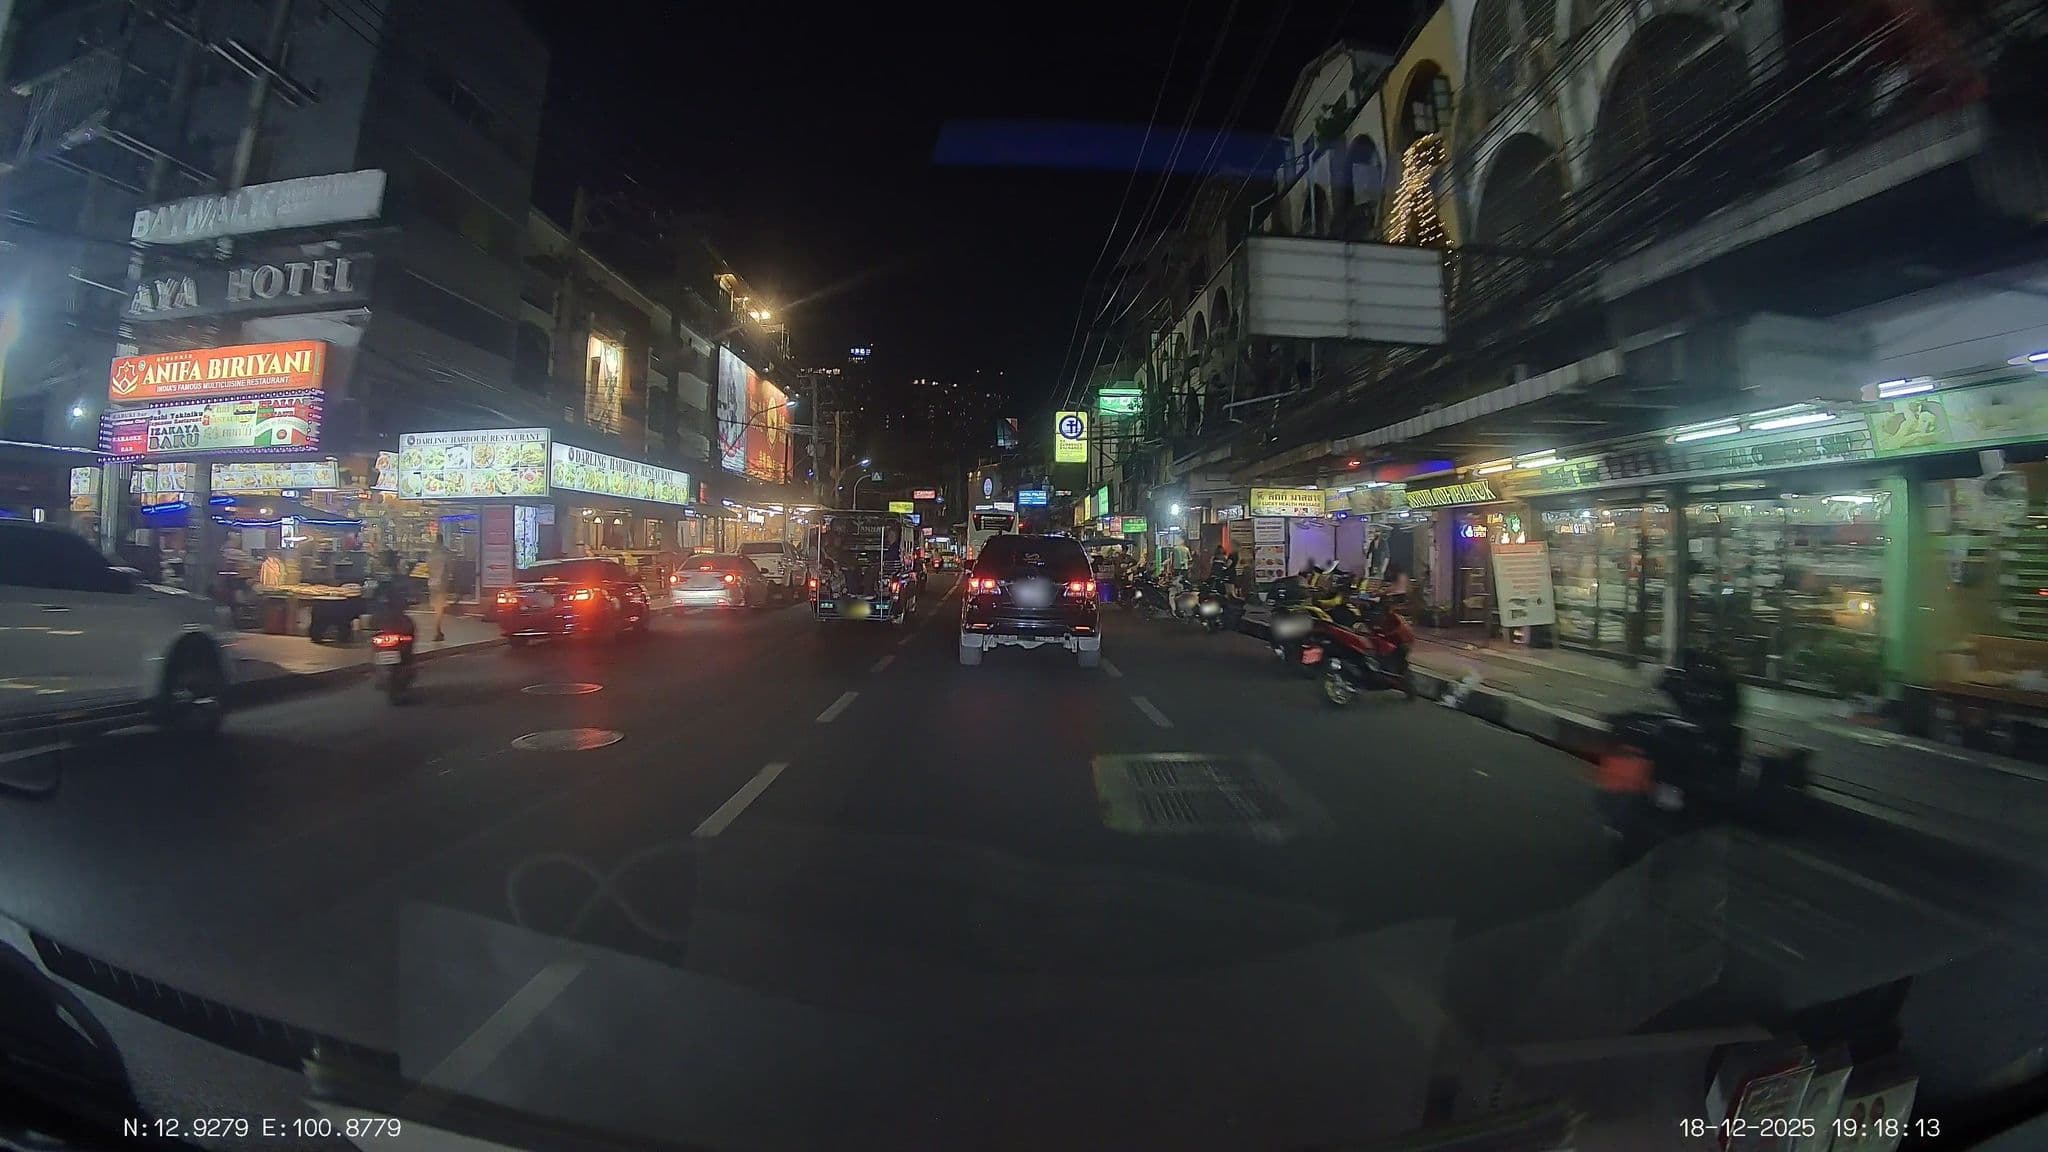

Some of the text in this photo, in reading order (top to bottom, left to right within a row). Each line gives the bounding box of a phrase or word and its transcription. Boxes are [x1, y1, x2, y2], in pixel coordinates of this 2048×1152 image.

[226, 257, 353, 303] HOTEL
[143, 350, 313, 385] ANIFA BIRIYANI
[178, 382, 202, 391] FAMOUS
[247, 376, 290, 387] RESTAURANT
[151, 424, 199, 436] IZAKAYA
[417, 433, 540, 445] DARLING HARBOUR RESTAURANT
[149, 433, 199, 450] BAKU
[576, 450, 673, 480] DARLING HARBOUR RESTAURANT
[1453, 480, 1496, 503] BLACK
